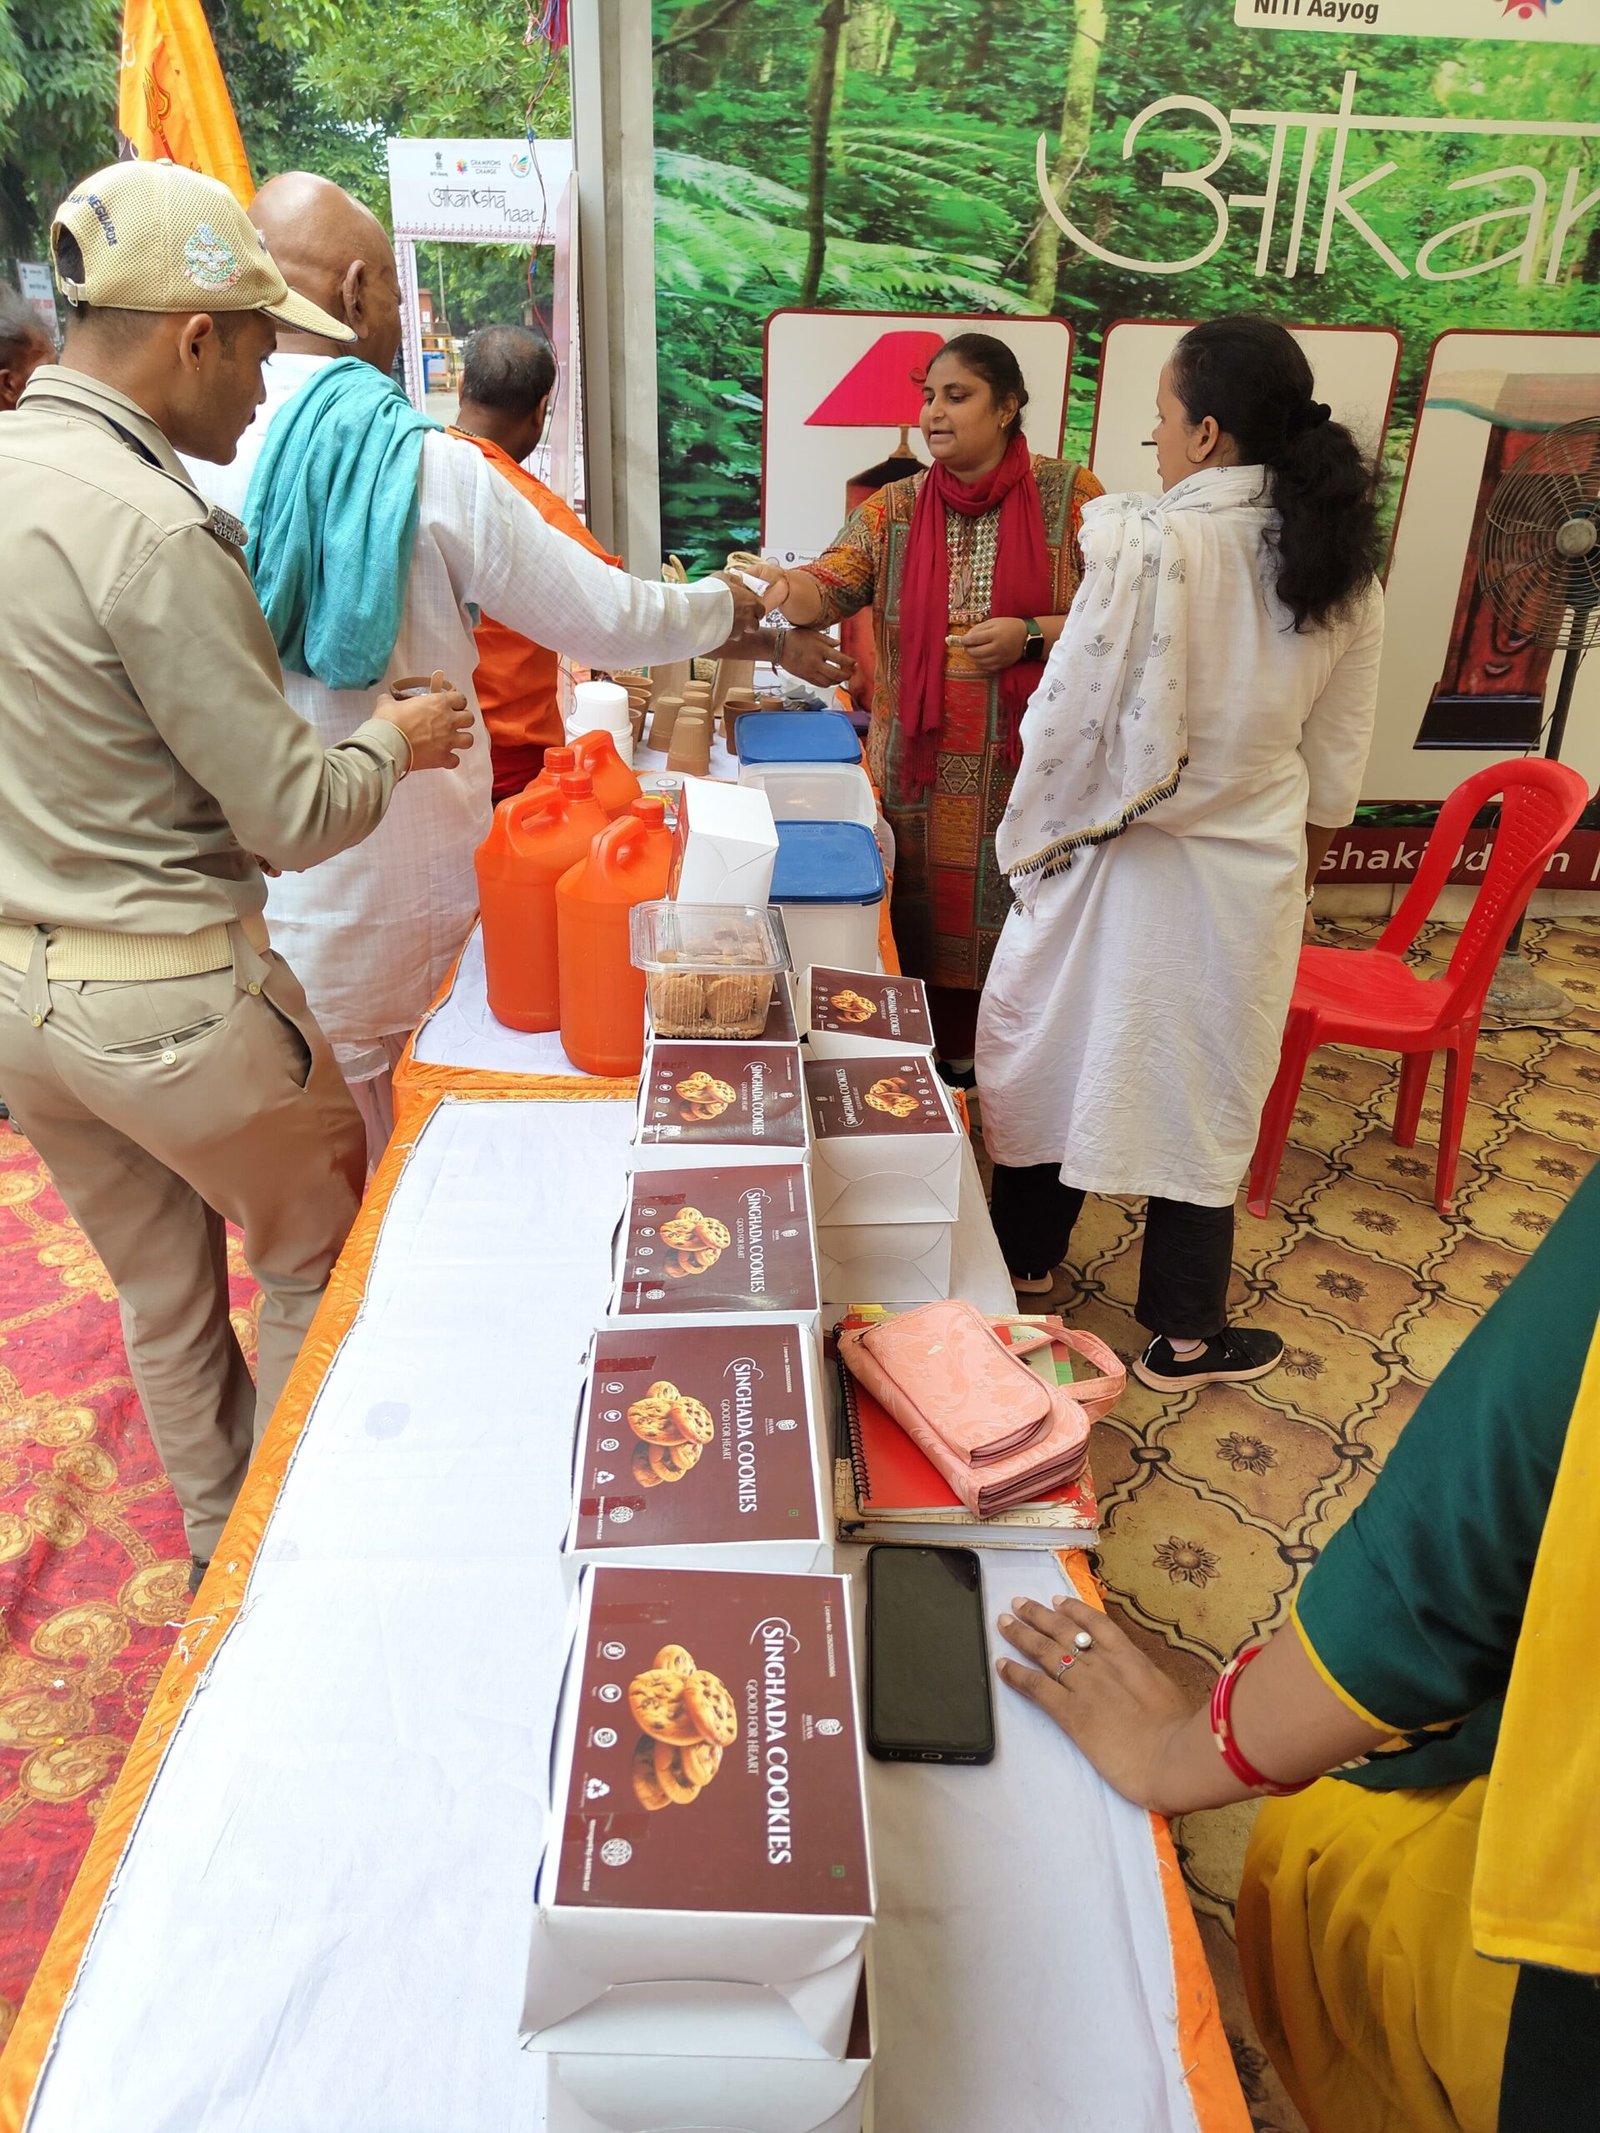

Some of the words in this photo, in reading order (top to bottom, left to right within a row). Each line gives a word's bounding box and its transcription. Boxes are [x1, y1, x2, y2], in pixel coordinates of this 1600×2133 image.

[1307, 0, 1380, 24] Aayog
[889, 1014, 901, 1036] COOKIES
[836, 1068, 850, 1094] COOKIES
[751, 1101, 765, 1135] COOKIES
[737, 1218, 745, 1236] GOOD
[745, 1191, 764, 1244] SINGHADA
[737, 1246, 745, 1260] HEART
[750, 1246, 765, 1293] COOKIES
[721, 1399, 730, 1425] GOOD
[732, 1362, 754, 1438] SINGHADA
[722, 1426, 731, 1438] FOR
[722, 1439, 732, 1461] HEART
[736, 1440, 757, 1513] COOKIES
[761, 1624, 788, 1743] SINGHADA
[745, 1679, 758, 1721] GOOD
[746, 1723, 759, 1742] FOR
[746, 1743, 760, 1776] HEART
[765, 1747, 791, 1865] COOKIES
